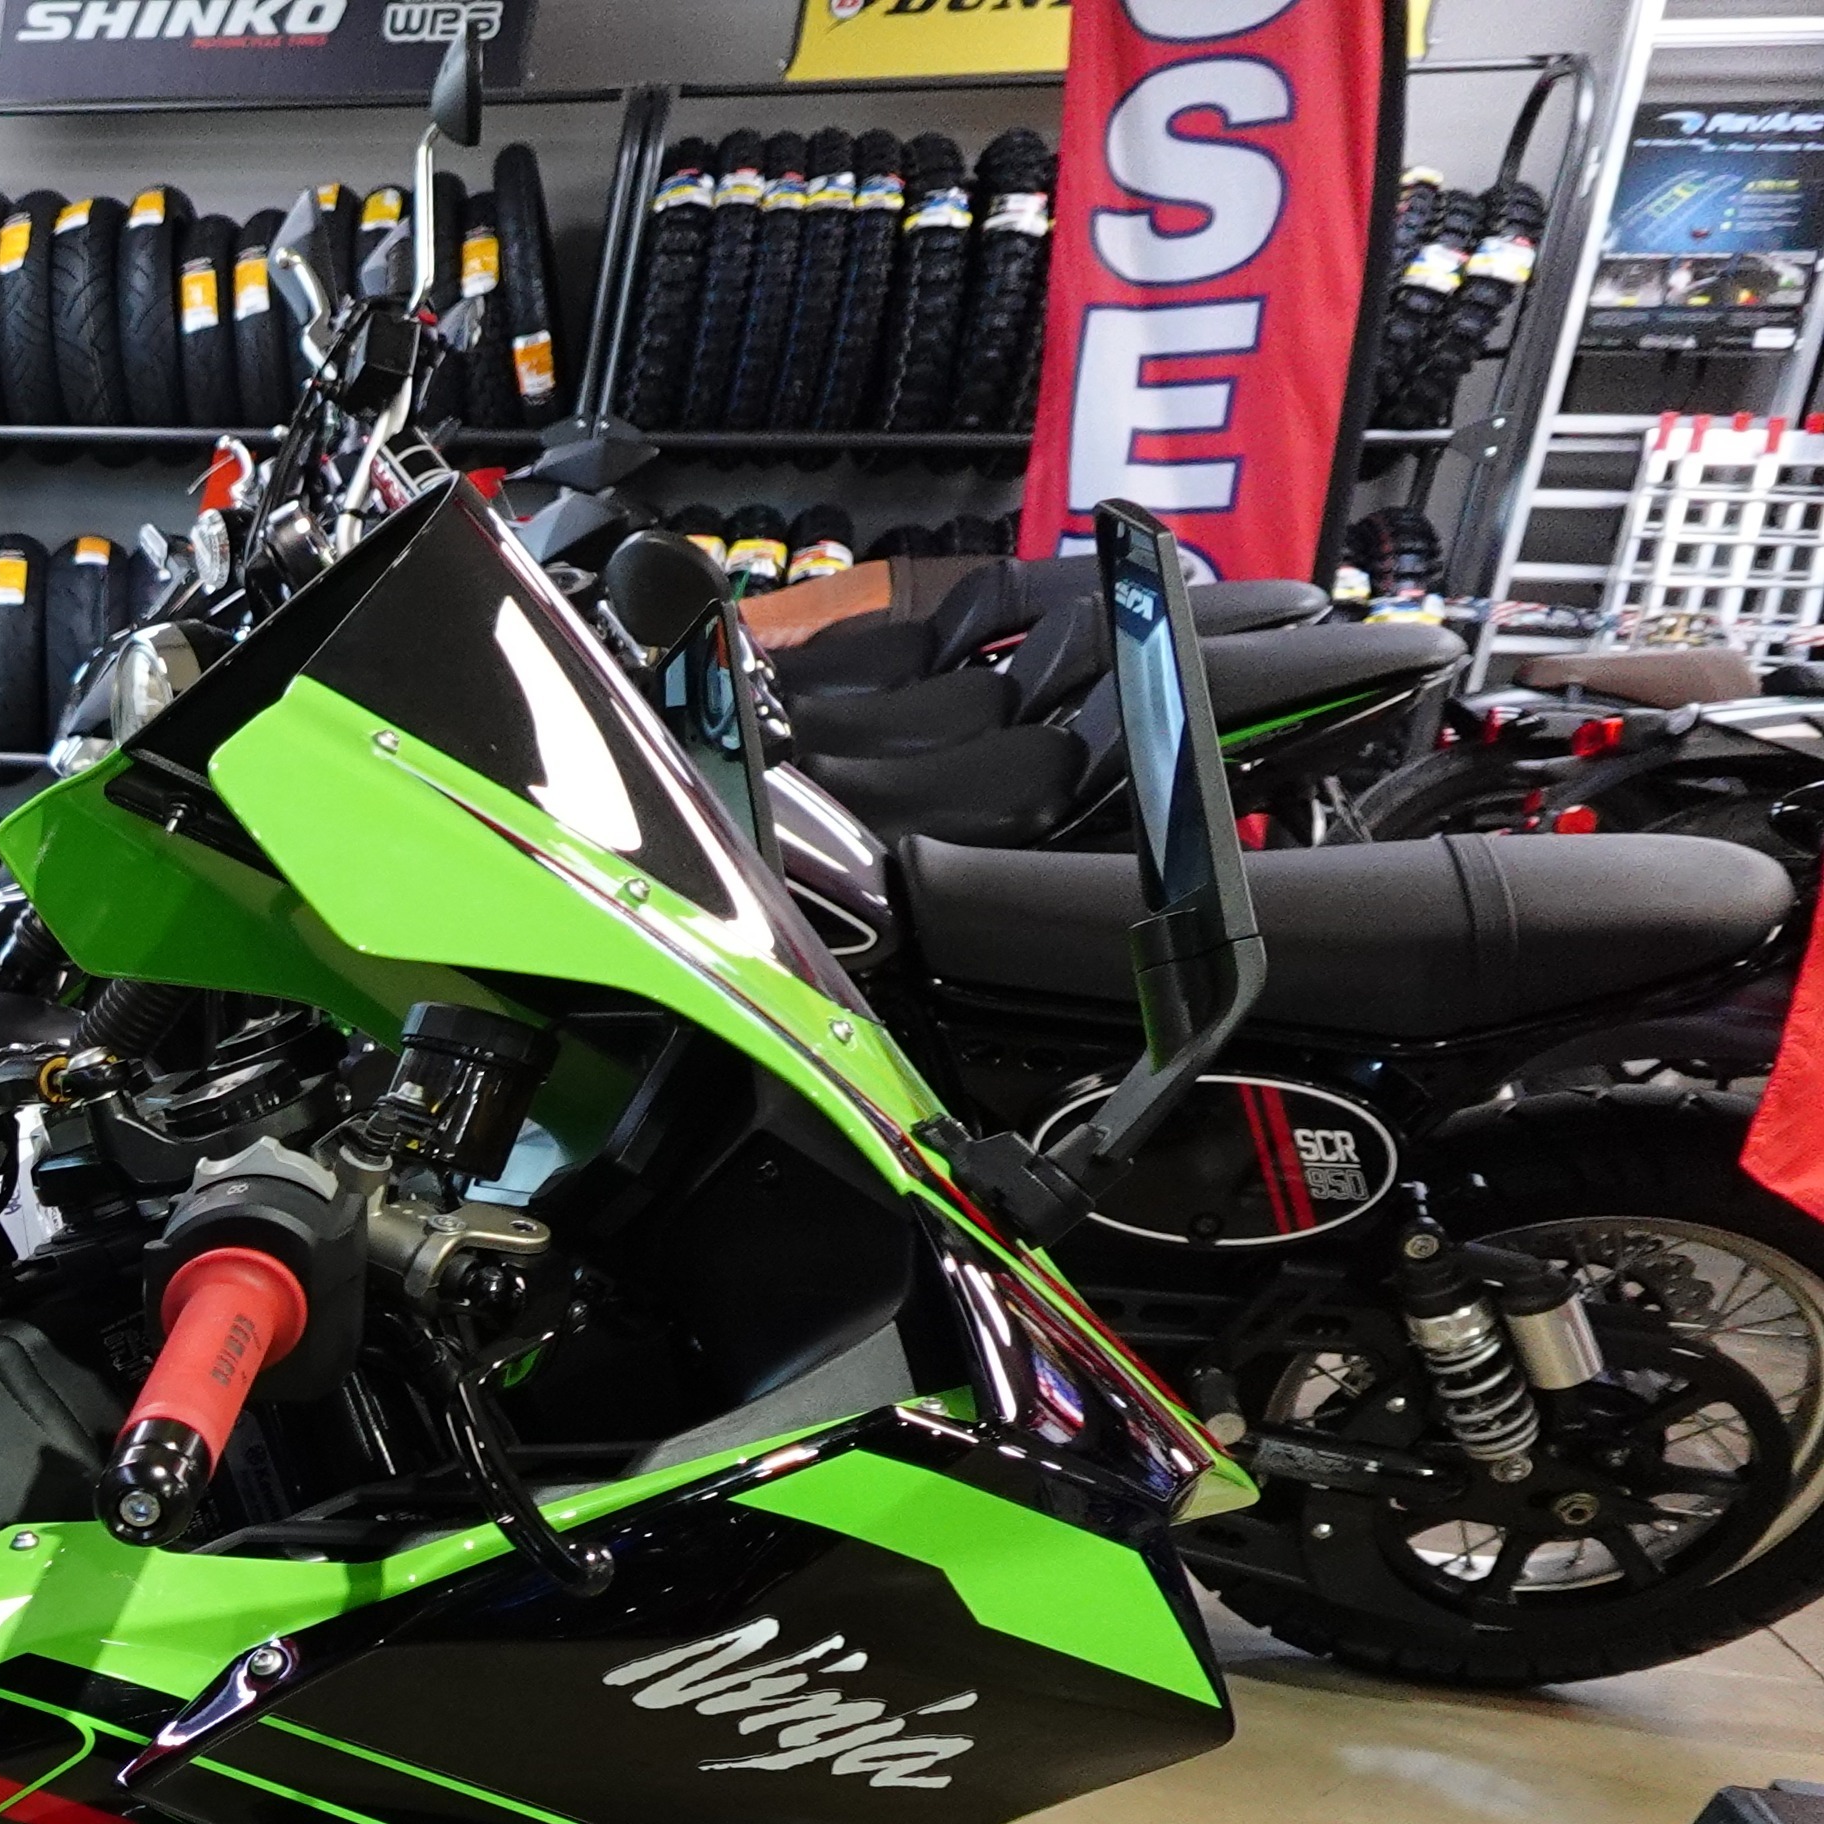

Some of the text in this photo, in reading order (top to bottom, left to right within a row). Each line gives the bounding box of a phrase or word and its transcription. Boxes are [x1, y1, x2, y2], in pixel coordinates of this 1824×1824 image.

[16, 0, 347, 42] SHINKO
[1294, 1127, 1360, 1163] SCR
[1306, 1168, 1370, 1202] 950
[601, 1613, 980, 1790] Ninja
